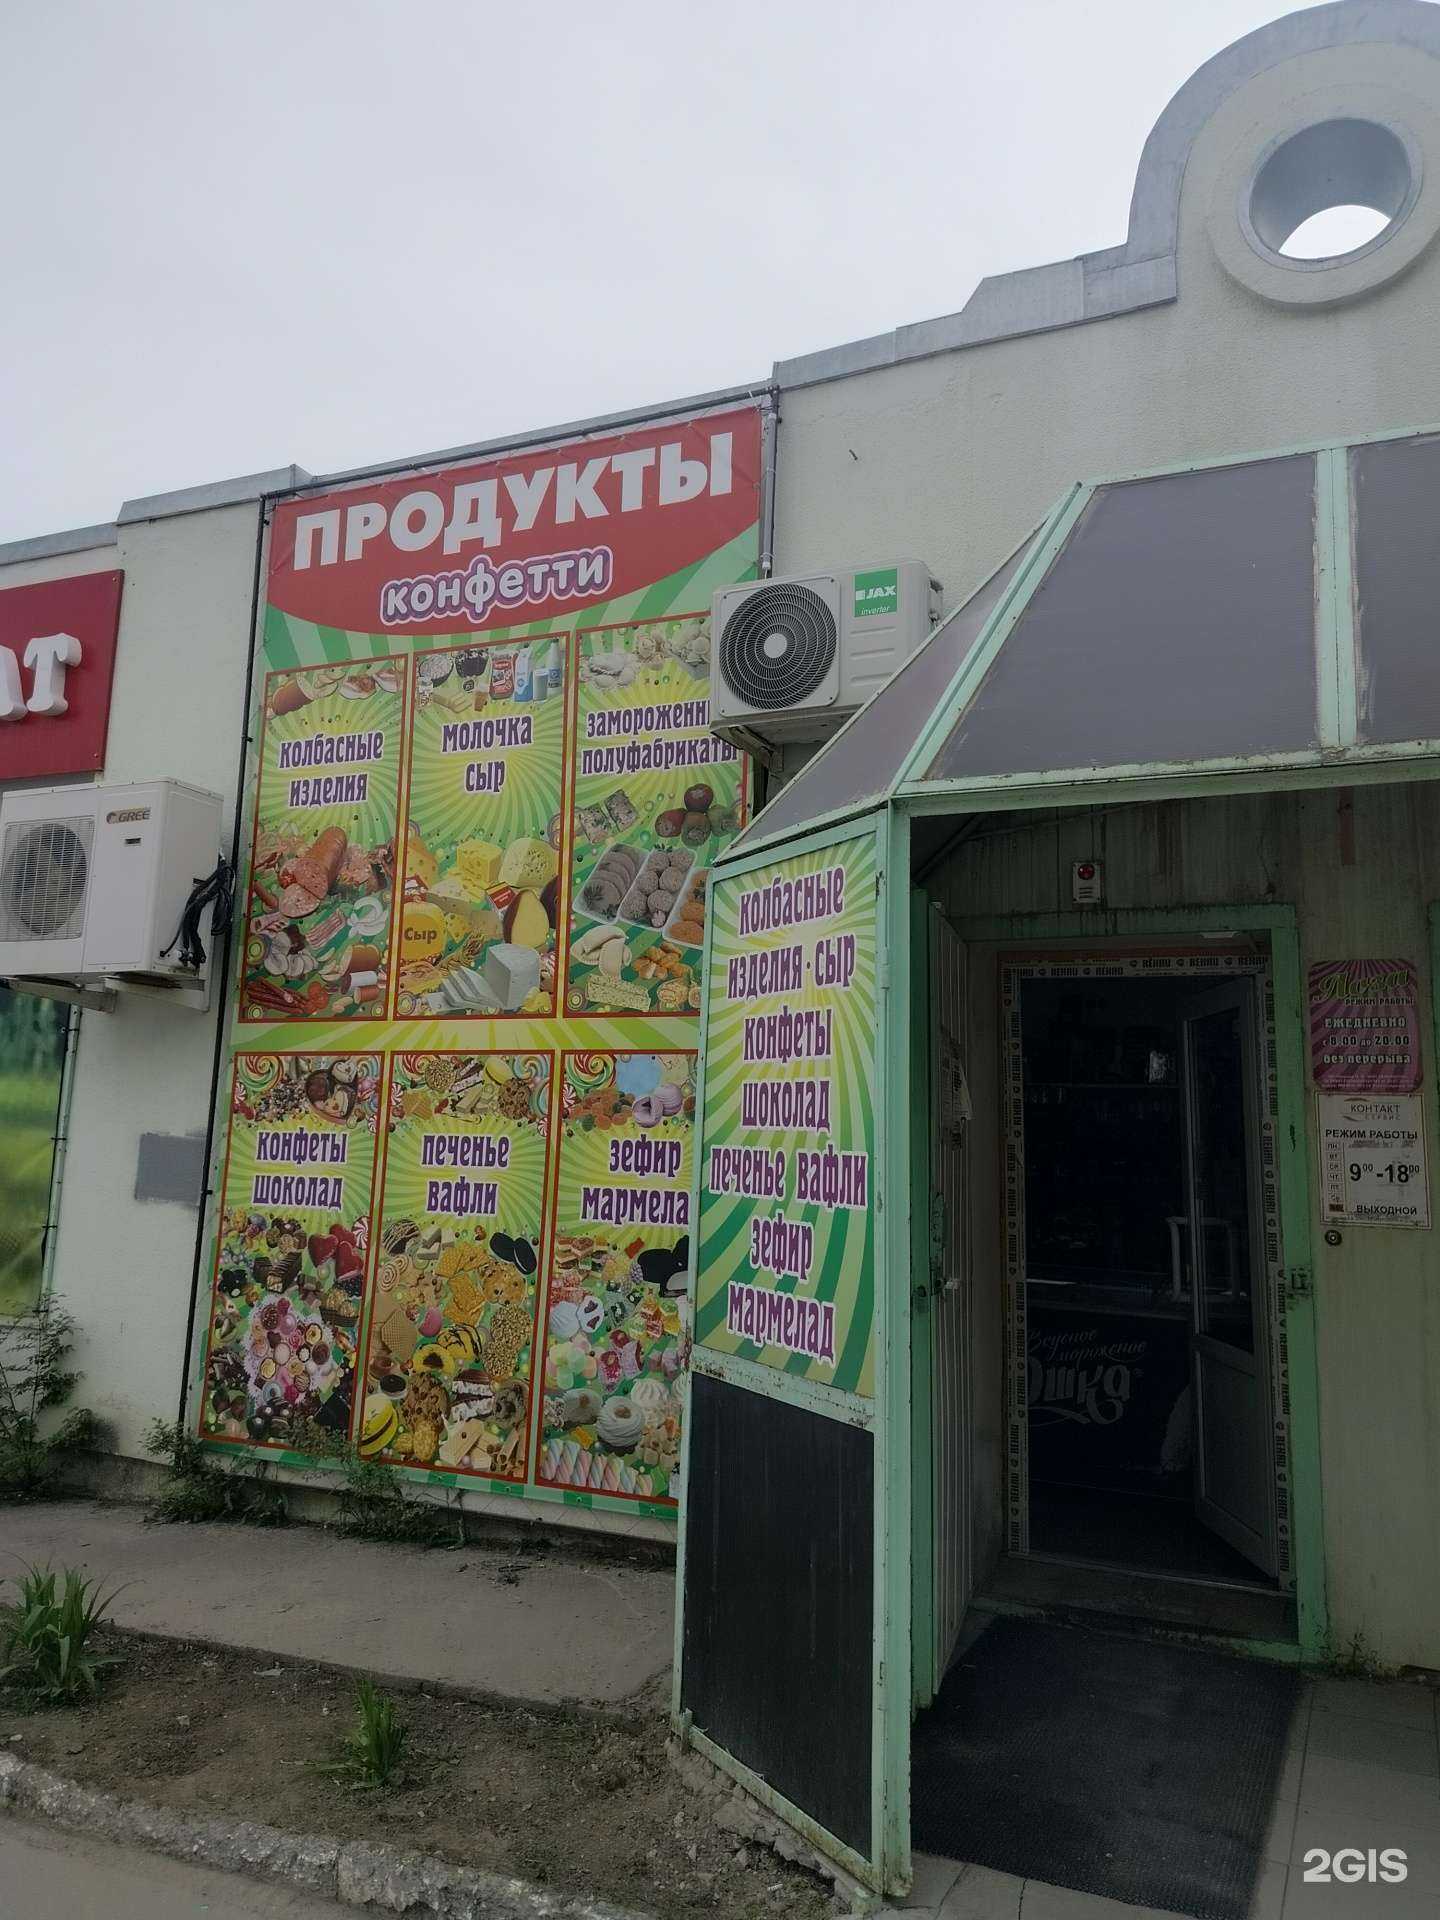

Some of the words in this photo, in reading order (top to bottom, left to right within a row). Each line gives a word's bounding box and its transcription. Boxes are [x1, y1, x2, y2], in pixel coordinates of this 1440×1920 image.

[293, 432, 732, 570] ПРОДУКТЫ
[383, 547, 612, 623] конфетти
[441, 715, 533, 752] молочка
[587, 700, 710, 738] замороженн
[279, 731, 384, 768] колбасные
[289, 772, 368, 807] изделия
[465, 758, 506, 792] сыр
[739, 865, 844, 935] колбасные
[404, 926, 437, 944] Сыр
[728, 944, 802, 1001] изделия
[814, 934, 854, 989] сыр
[743, 1005, 832, 1063] конфеты
[1329, 1036, 1358, 1046] 8.00
[1374, 1035, 1410, 1046] 20.00
[742, 1080, 830, 1132] шоколад
[1351, 1104, 1400, 1113] КОНТАКТ
[257, 1127, 347, 1165] конфеты
[422, 1133, 509, 1168] печенье
[1325, 1129, 1366, 1139] РЕЖИМ
[1370, 1130, 1418, 1140] РАБОТЫ
[610, 1133, 681, 1178] зефир
[710, 1145, 786, 1198] печенье
[797, 1144, 867, 1206] вафли
[253, 1174, 343, 1211] шоколад
[427, 1176, 499, 1216] вафли
[582, 1185, 689, 1225] мармела
[751, 1213, 812, 1279] зефир
[727, 1283, 835, 1362] мармелад
